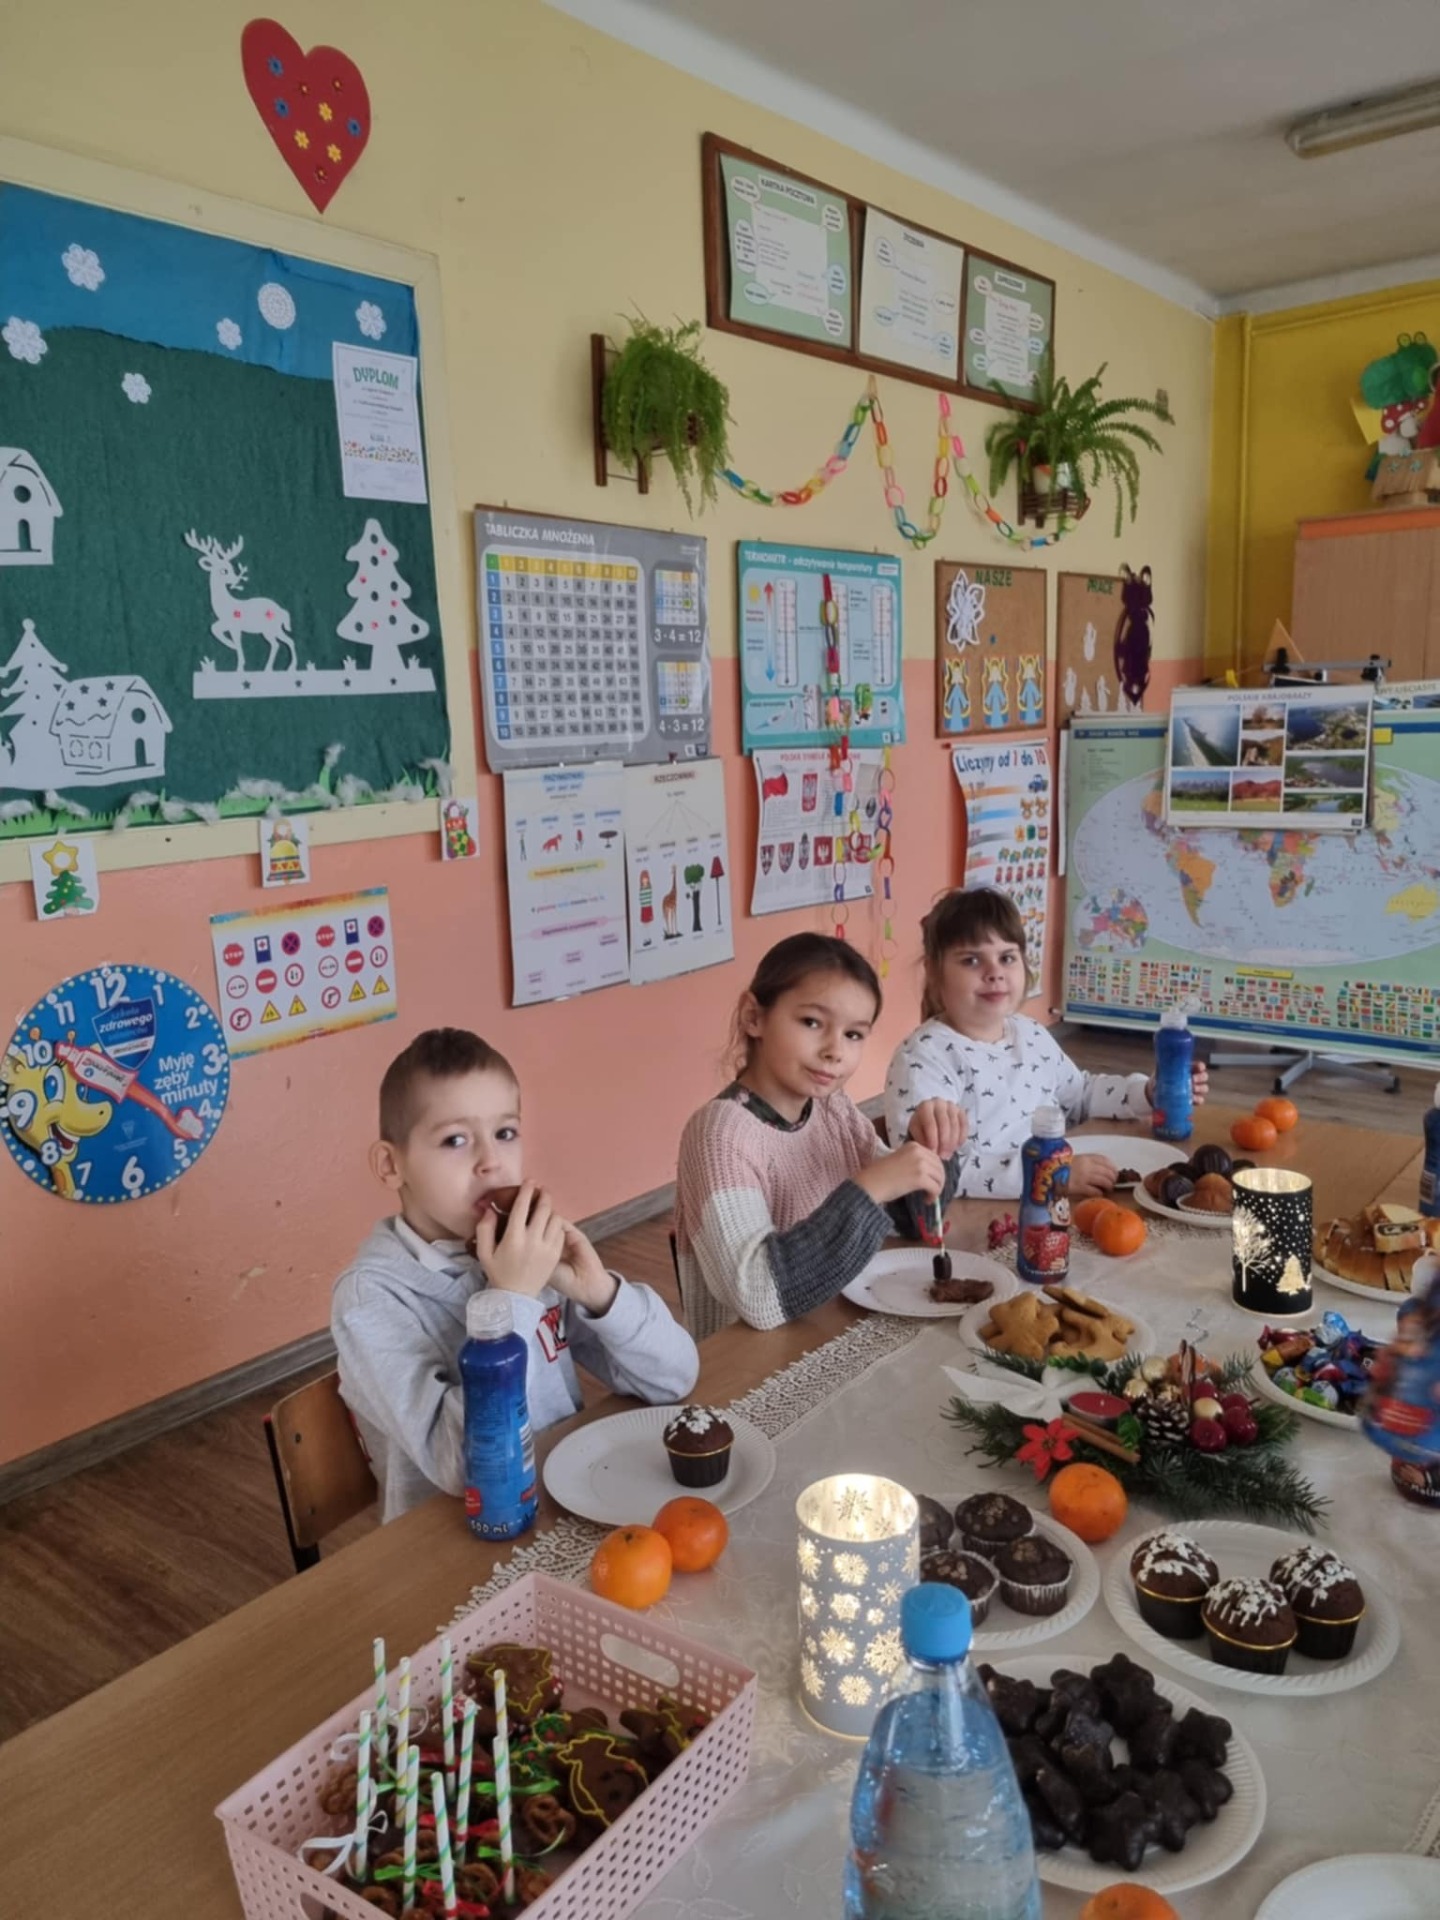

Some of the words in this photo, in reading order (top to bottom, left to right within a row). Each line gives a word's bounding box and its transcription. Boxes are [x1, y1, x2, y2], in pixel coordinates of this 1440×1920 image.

[352, 366, 399, 389] DYPLOM
[485, 523, 539, 540] TABLICZKA
[541, 528, 594, 546] MNOŻENIA
[975, 570, 1012, 587] NASZE
[1087, 577, 1114, 595] PRACE
[654, 629, 662, 642] 3
[669, 629, 676, 643] 4
[689, 629, 702, 643] 12
[1227, 693, 1259, 702] POLSKIE
[659, 719, 666, 733] 4
[673, 719, 680, 733] 3
[691, 718, 705, 732] 12
[998, 751, 1010, 768] od
[1013, 750, 1018, 766] 1
[1021, 750, 1034, 766] do
[316, 933, 335, 941] STOP
[224, 950, 244, 959] STOP
[90, 972, 129, 1010] 12
[153, 983, 164, 1006] 1
[54, 1000, 76, 1025] 11
[99, 1013, 153, 1033] zdrowego
[186, 1007, 201, 1029] 2
[22, 1041, 52, 1067] 10
[159, 1052, 195, 1074] Myję
[202, 1043, 223, 1076] 3
[154, 1070, 190, 1091] zęby
[161, 1079, 218, 1105] minuty
[8, 1090, 35, 1128] 9
[198, 1101, 213, 1118] 4
[41, 1140, 60, 1165] 8
[174, 1138, 188, 1160] 5
[77, 1161, 92, 1186] 7
[122, 1155, 145, 1190] 6
